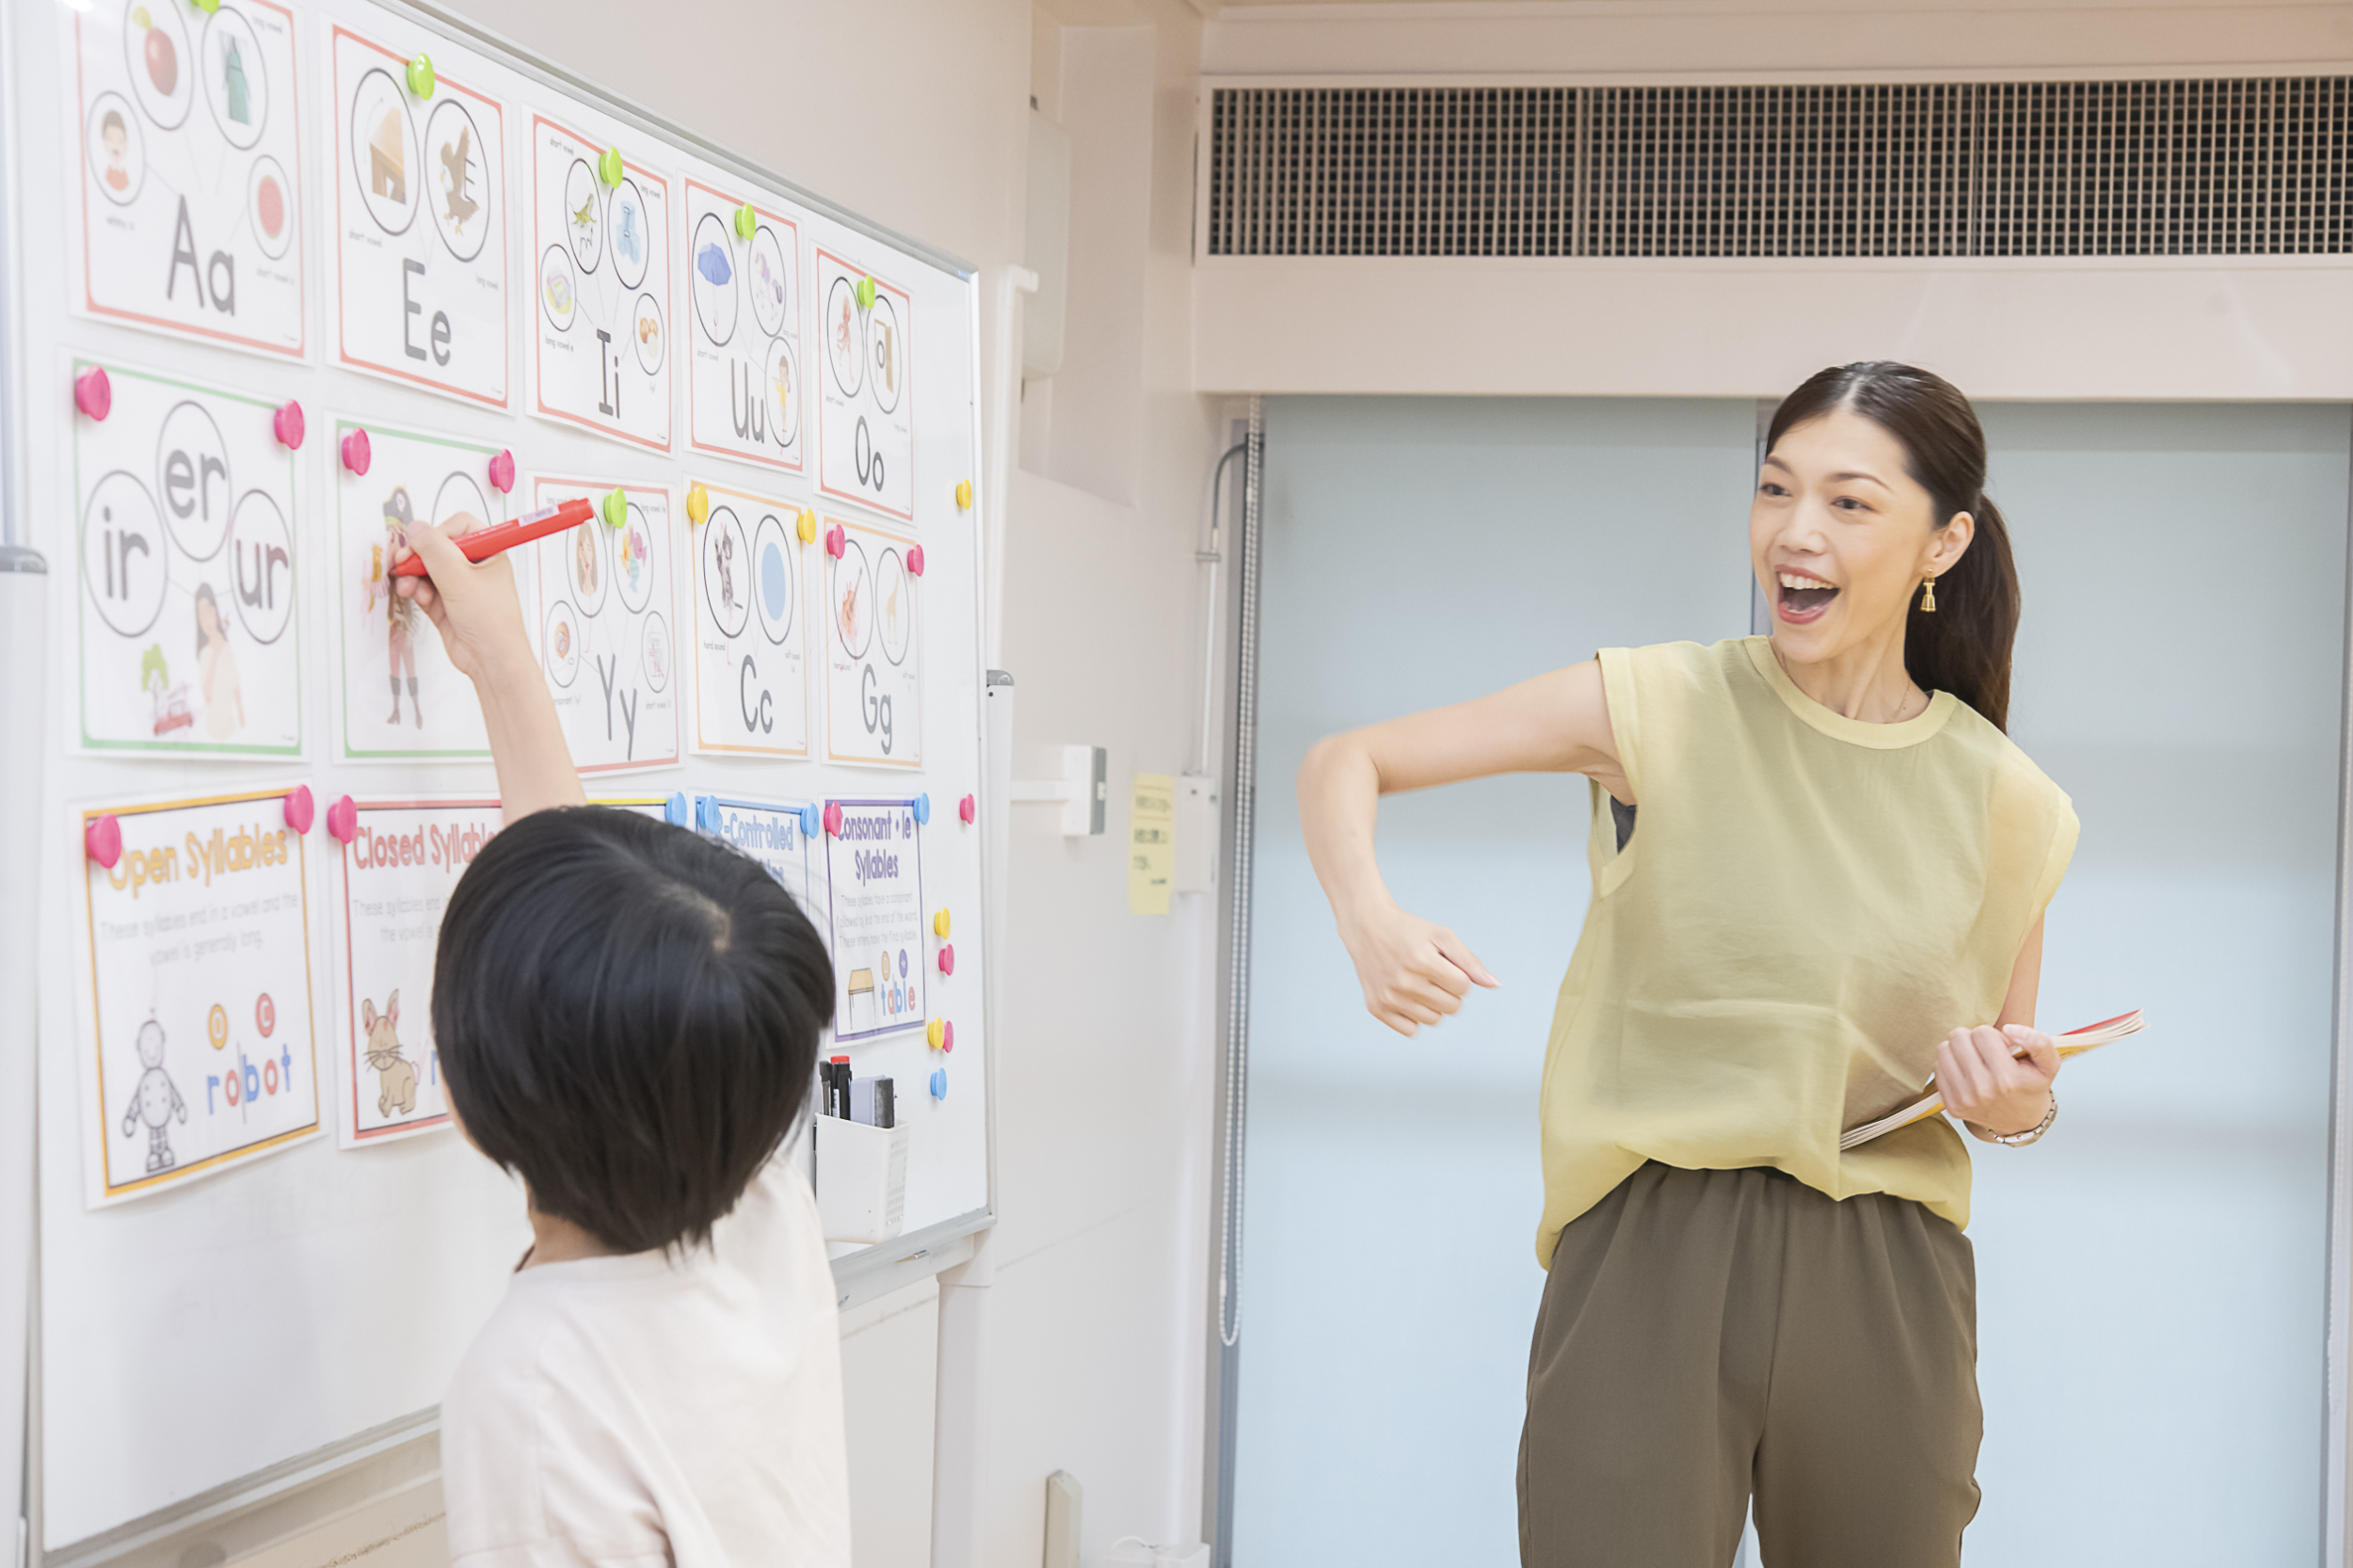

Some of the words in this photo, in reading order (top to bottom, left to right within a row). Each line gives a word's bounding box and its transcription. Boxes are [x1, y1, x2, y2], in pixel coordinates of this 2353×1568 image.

[167, 193, 235, 317] Aa
[403, 257, 453, 367] Ee
[596, 328, 620, 420] Ii
[730, 358, 765, 445] Uu
[165, 449, 227, 521] er
[855, 415, 885, 492] Oo
[102, 505, 150, 602] ir
[235, 538, 290, 611] ur
[597, 652, 638, 761] Yy
[741, 654, 773, 735] Cc
[861, 663, 892, 755] Gg
[185, 823, 288, 888] Syllables
[353, 824, 424, 870] Closed
[429, 822, 503, 874] Syllabl
[902, 809, 912, 840] le
[855, 848, 899, 888] Syllables
[880, 979, 916, 1016] table
[206, 1044, 292, 1115] robot
